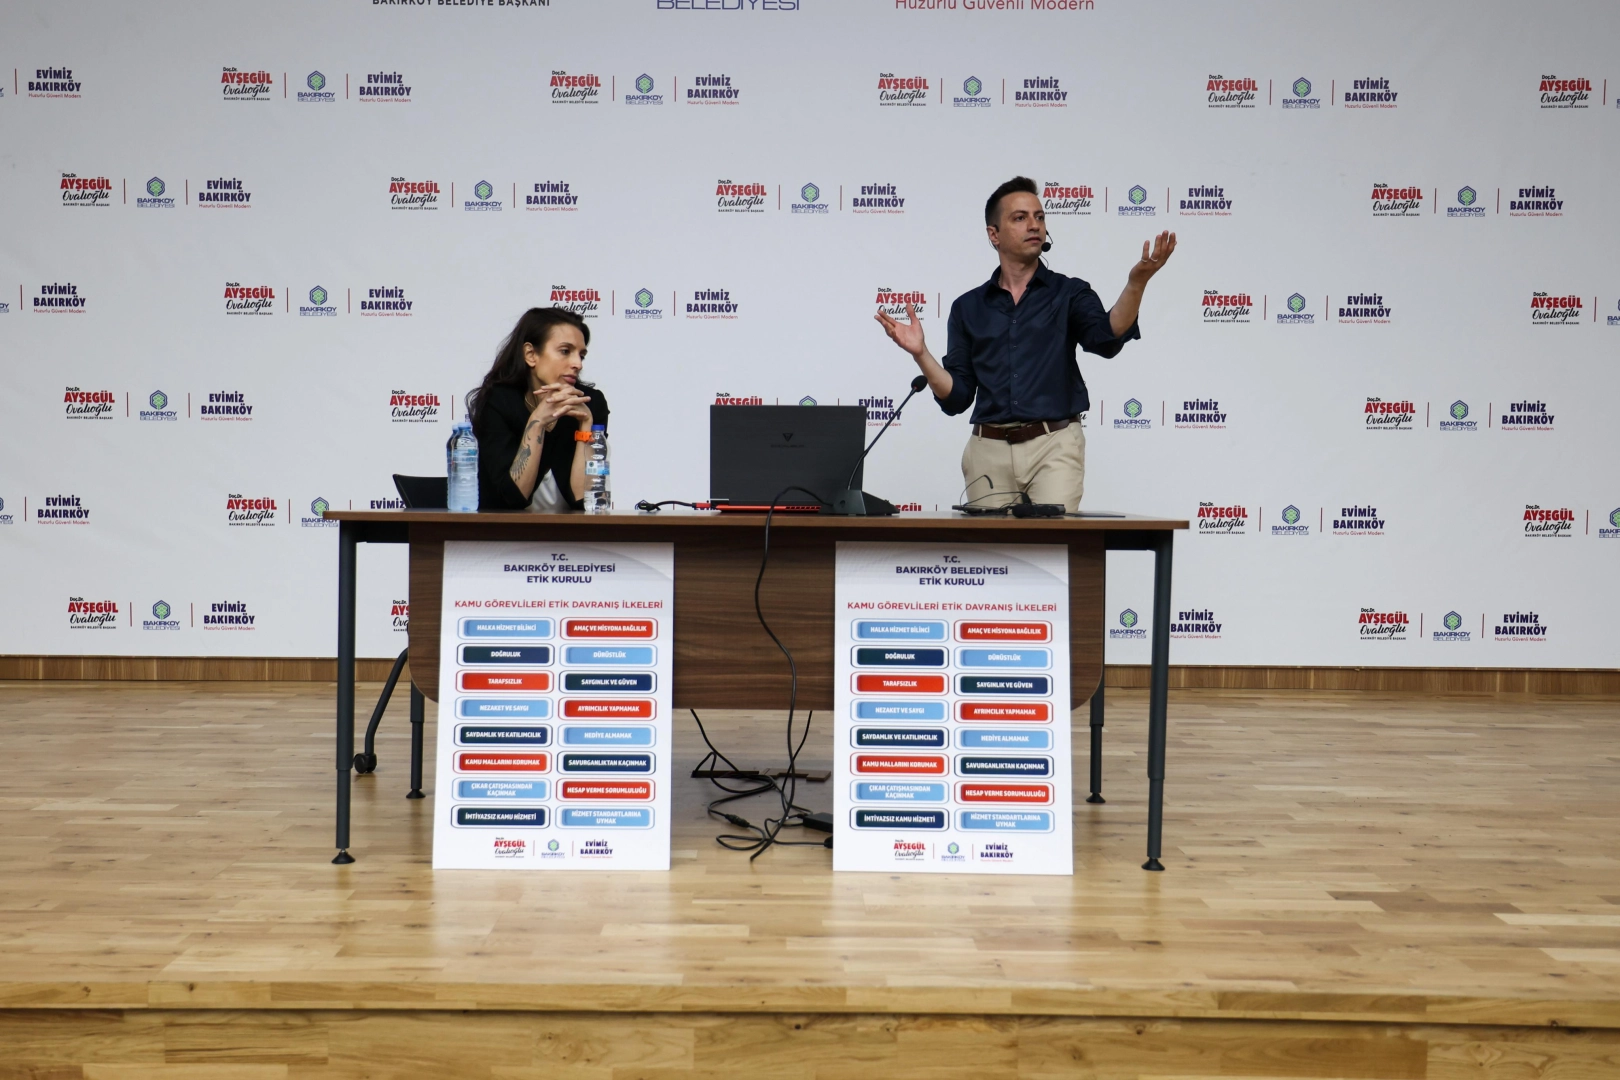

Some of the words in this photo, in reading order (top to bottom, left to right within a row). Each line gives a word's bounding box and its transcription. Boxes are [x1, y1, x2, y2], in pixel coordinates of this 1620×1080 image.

[1031, 0, 1094, 10] Modern
[36, 67, 72, 79] EVİMİZ
[221, 71, 272, 86] AYŞEGÜL
[367, 71, 403, 83] EVİMİZ
[28, 80, 80, 91] BAKIRKÖY
[550, 74, 601, 89] AYŞEGÜL
[695, 74, 731, 86] EVİMİZ
[878, 76, 929, 91] AYŞEGÜL
[1023, 76, 1059, 88] EVİMİZ
[1207, 78, 1258, 93] AYŞEGÜL
[1353, 77, 1389, 89] EVİMİZ
[1540, 78, 1591, 93] AYŞEGÜL
[359, 84, 411, 95] BAKIRKÖY
[687, 87, 739, 98] BAKIRKÖY
[1015, 89, 1067, 100] BAKIRKÖY
[1345, 90, 1397, 101] BAKIRKÖY
[61, 177, 112, 192] AYŞEGÜL
[207, 177, 243, 189] EVİMİZ
[389, 180, 440, 195] AYŞEGÜL
[534, 180, 570, 192] EVİMİZ
[861, 183, 897, 195] EVİMİZ
[199, 190, 251, 201] BAKIRKÖY
[716, 183, 767, 198] AYŞEGÜL
[1043, 185, 1094, 200] AYŞEGÜL
[1188, 185, 1224, 197] EVİMİZ
[1371, 187, 1422, 202] AYŞEGÜL
[1519, 186, 1555, 198] EVİMİZ
[526, 193, 578, 204] BAKIRKÖY
[853, 196, 905, 207] BAKIRKÖY
[1180, 198, 1232, 209] BAKIRKÖY
[1511, 199, 1563, 210] BAKIRKÖY
[41, 283, 77, 295] EVİMİZ
[224, 286, 275, 301] AYŞEGÜL
[368, 286, 404, 298] EVİMİZ
[694, 288, 730, 300] EVİMİZ
[33, 296, 85, 307] BAKIRKÖY
[550, 288, 601, 303] AYŞEGÜL
[876, 291, 927, 306] AYŞEGÜL
[1202, 293, 1253, 308] AYŞEGÜL
[1347, 293, 1383, 305] EVİMİZ
[360, 299, 412, 310] BAKIRKÖY
[686, 301, 738, 312] BAKIRKÖY
[1531, 295, 1582, 310] AYŞEGÜL
[1339, 306, 1391, 317] BAKIRKÖY
[64, 390, 115, 405] AYŞEGÜL
[209, 390, 245, 402] EVİMİZ
[390, 393, 441, 408] AYŞEGÜL
[201, 403, 253, 414] BAKIRKÖY
[1183, 398, 1219, 410] EVİMİZ
[1365, 400, 1416, 415] AYŞEGÜL
[1510, 400, 1546, 412] EVİMİZ
[1175, 411, 1227, 422] BAKIRKÖY
[1502, 413, 1554, 424] BAKIRKÖY
[45, 494, 81, 506] EVİMİZ
[226, 497, 277, 512] AYŞEGÜL
[37, 507, 89, 518] BAKIRKÖY
[1197, 505, 1248, 520] AYŞEGÜL
[1341, 505, 1377, 517] EVİMİZ
[1523, 508, 1574, 523] AYŞEGÜL
[1333, 518, 1385, 529] BAKIRKÖY
[551, 553, 568, 561] T.C.
[943, 555, 960, 563] T.C.
[504, 563, 556, 572] BAKIRKÖY
[558, 563, 616, 572] BELEDİYESİ
[896, 565, 948, 574] BAKIRKÖY
[951, 565, 1008, 575] BELEDİYESİ
[527, 574, 549, 583] ETİK
[919, 576, 941, 585] ETİK
[944, 578, 985, 586] KURULU
[68, 600, 119, 615] AYŞEGÜL
[211, 600, 247, 612] EVİMİZ
[455, 600, 482, 608] KAMU
[484, 599, 546, 608] GÖREVLİLERİ
[549, 600, 569, 608] ETİK
[572, 601, 619, 609] DAVRANIŞ
[622, 600, 663, 609] İLKELERİ
[877, 601, 939, 610] GÖREVLİLERİ
[942, 602, 962, 610] ETİK
[965, 603, 1013, 612] DAVRANIŞ
[1016, 603, 1057, 612] İLKELERİ
[203, 613, 255, 624] BAKIRKÖY
[1178, 608, 1214, 620] EVİMİZ
[1358, 611, 1409, 626] AYŞEGÜL
[1503, 611, 1539, 623] EVİMİZ
[1170, 621, 1222, 632] BAKIRKÖY
[1495, 624, 1547, 635] BAKIRKÖY
[885, 652, 915, 660] DOĞRULUK
[605, 786, 647, 794] SORUMLULUĞU
